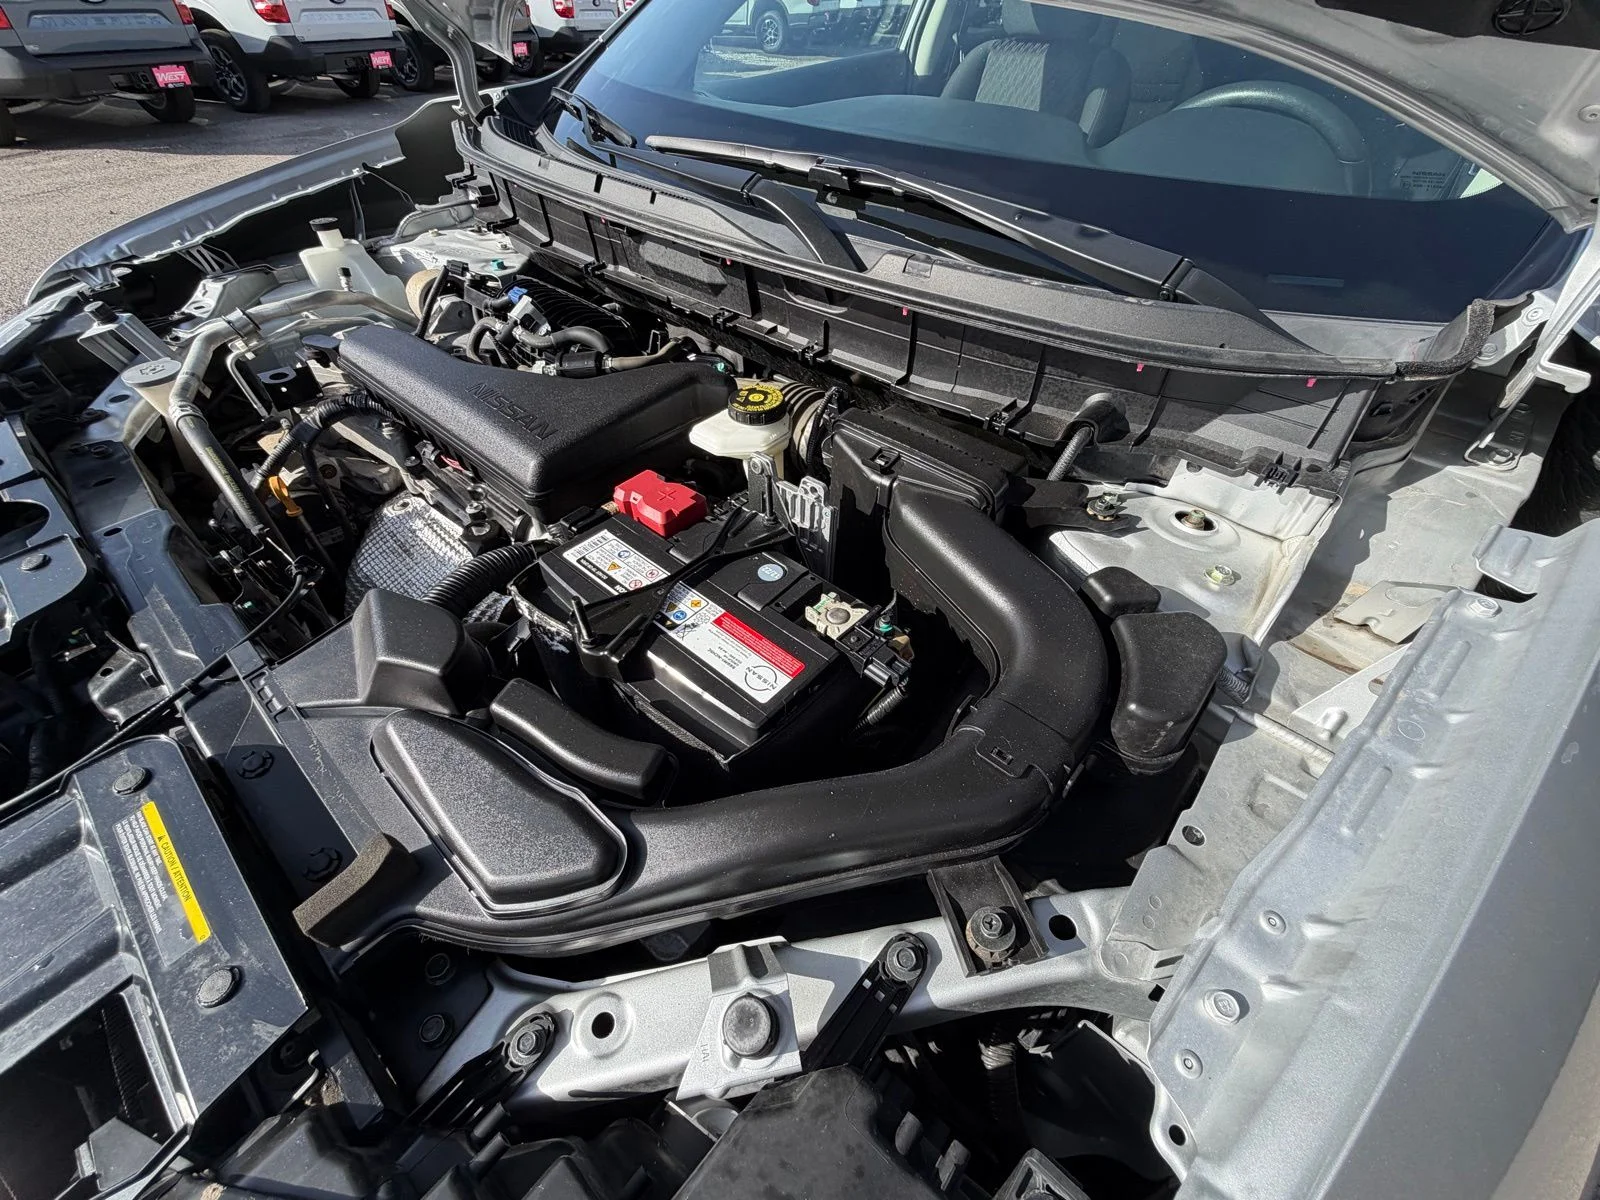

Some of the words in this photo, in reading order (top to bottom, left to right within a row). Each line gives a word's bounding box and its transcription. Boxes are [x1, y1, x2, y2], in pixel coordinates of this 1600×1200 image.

[40, 15, 162, 29] MAVERICK
[156, 70, 186, 82] WEST
[465, 382, 559, 441] NISSAN
[745, 666, 778, 689] NISSAN
[161, 841, 177, 867] CAUTION
[172, 870, 192, 902] ATTENTION
